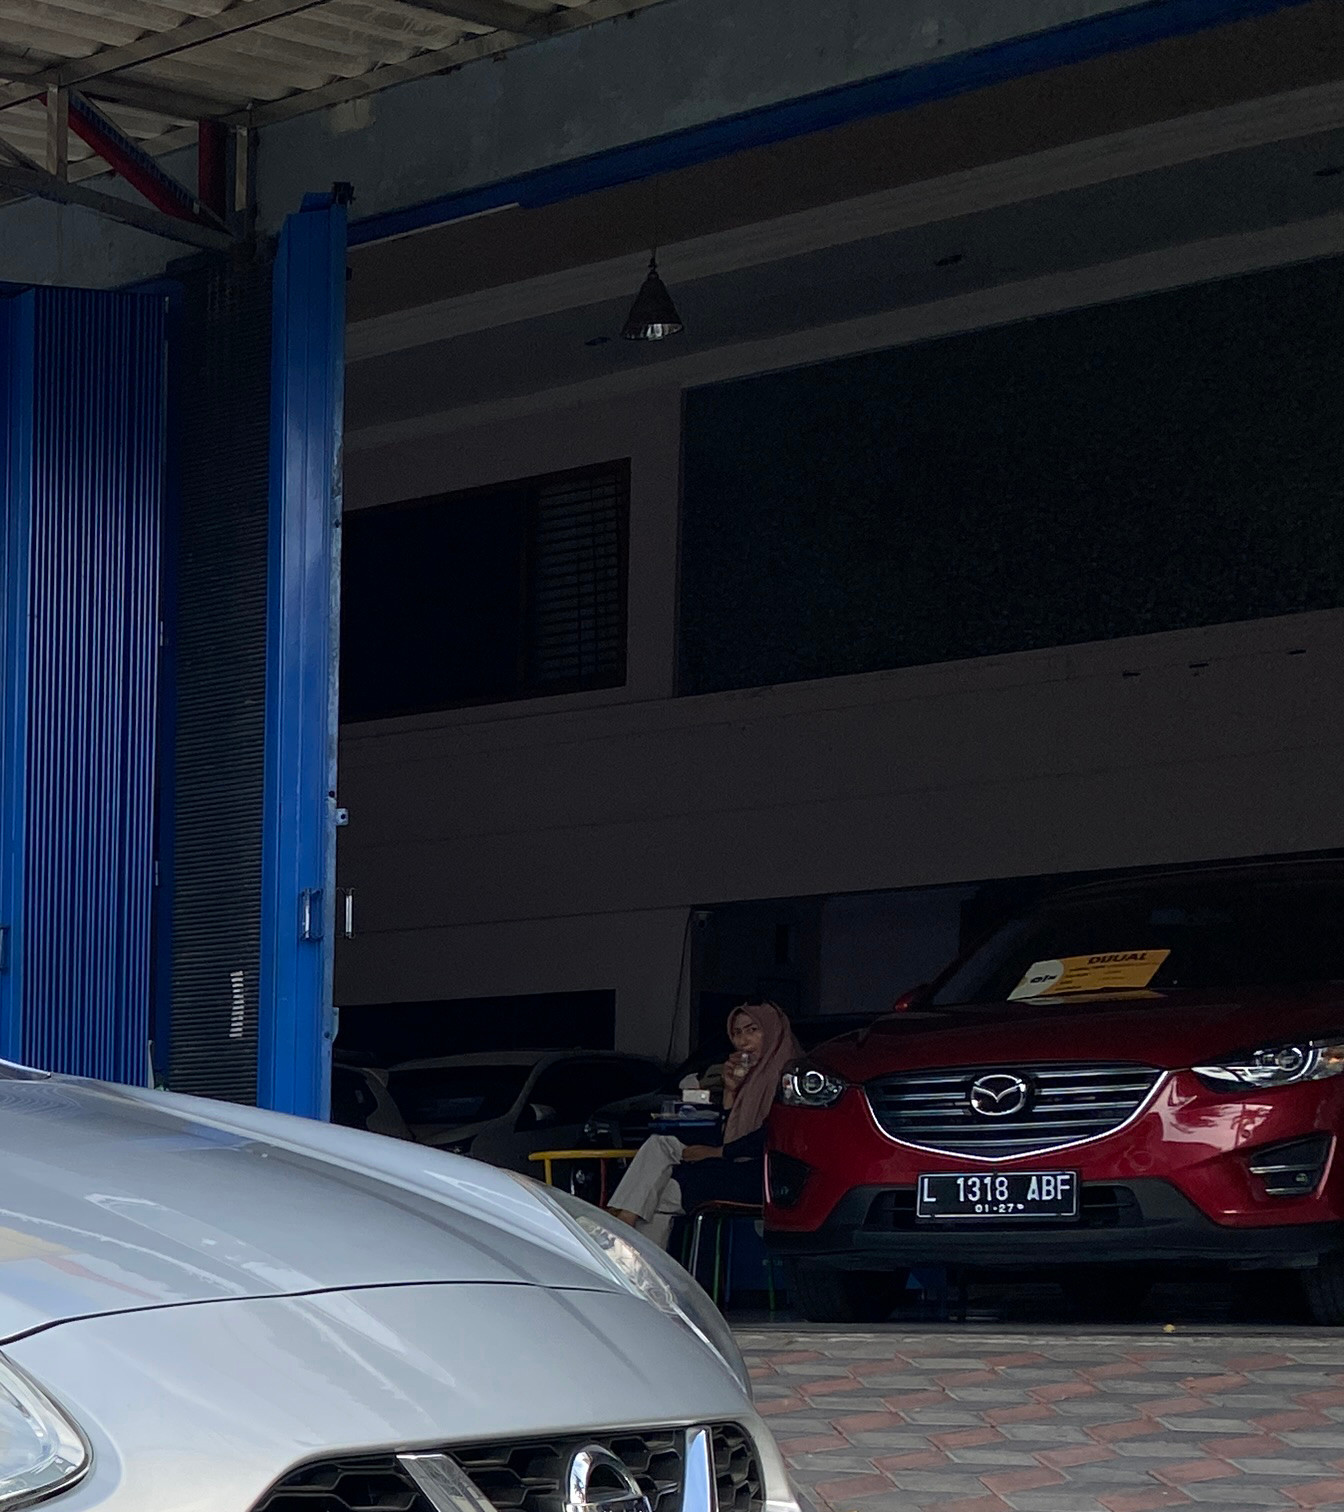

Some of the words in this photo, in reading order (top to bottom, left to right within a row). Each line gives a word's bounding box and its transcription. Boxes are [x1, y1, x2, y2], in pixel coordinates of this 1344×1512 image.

[923, 1178, 937, 1202] L
[956, 1176, 1009, 1202] 1318
[1026, 1174, 1071, 1201] ABF
